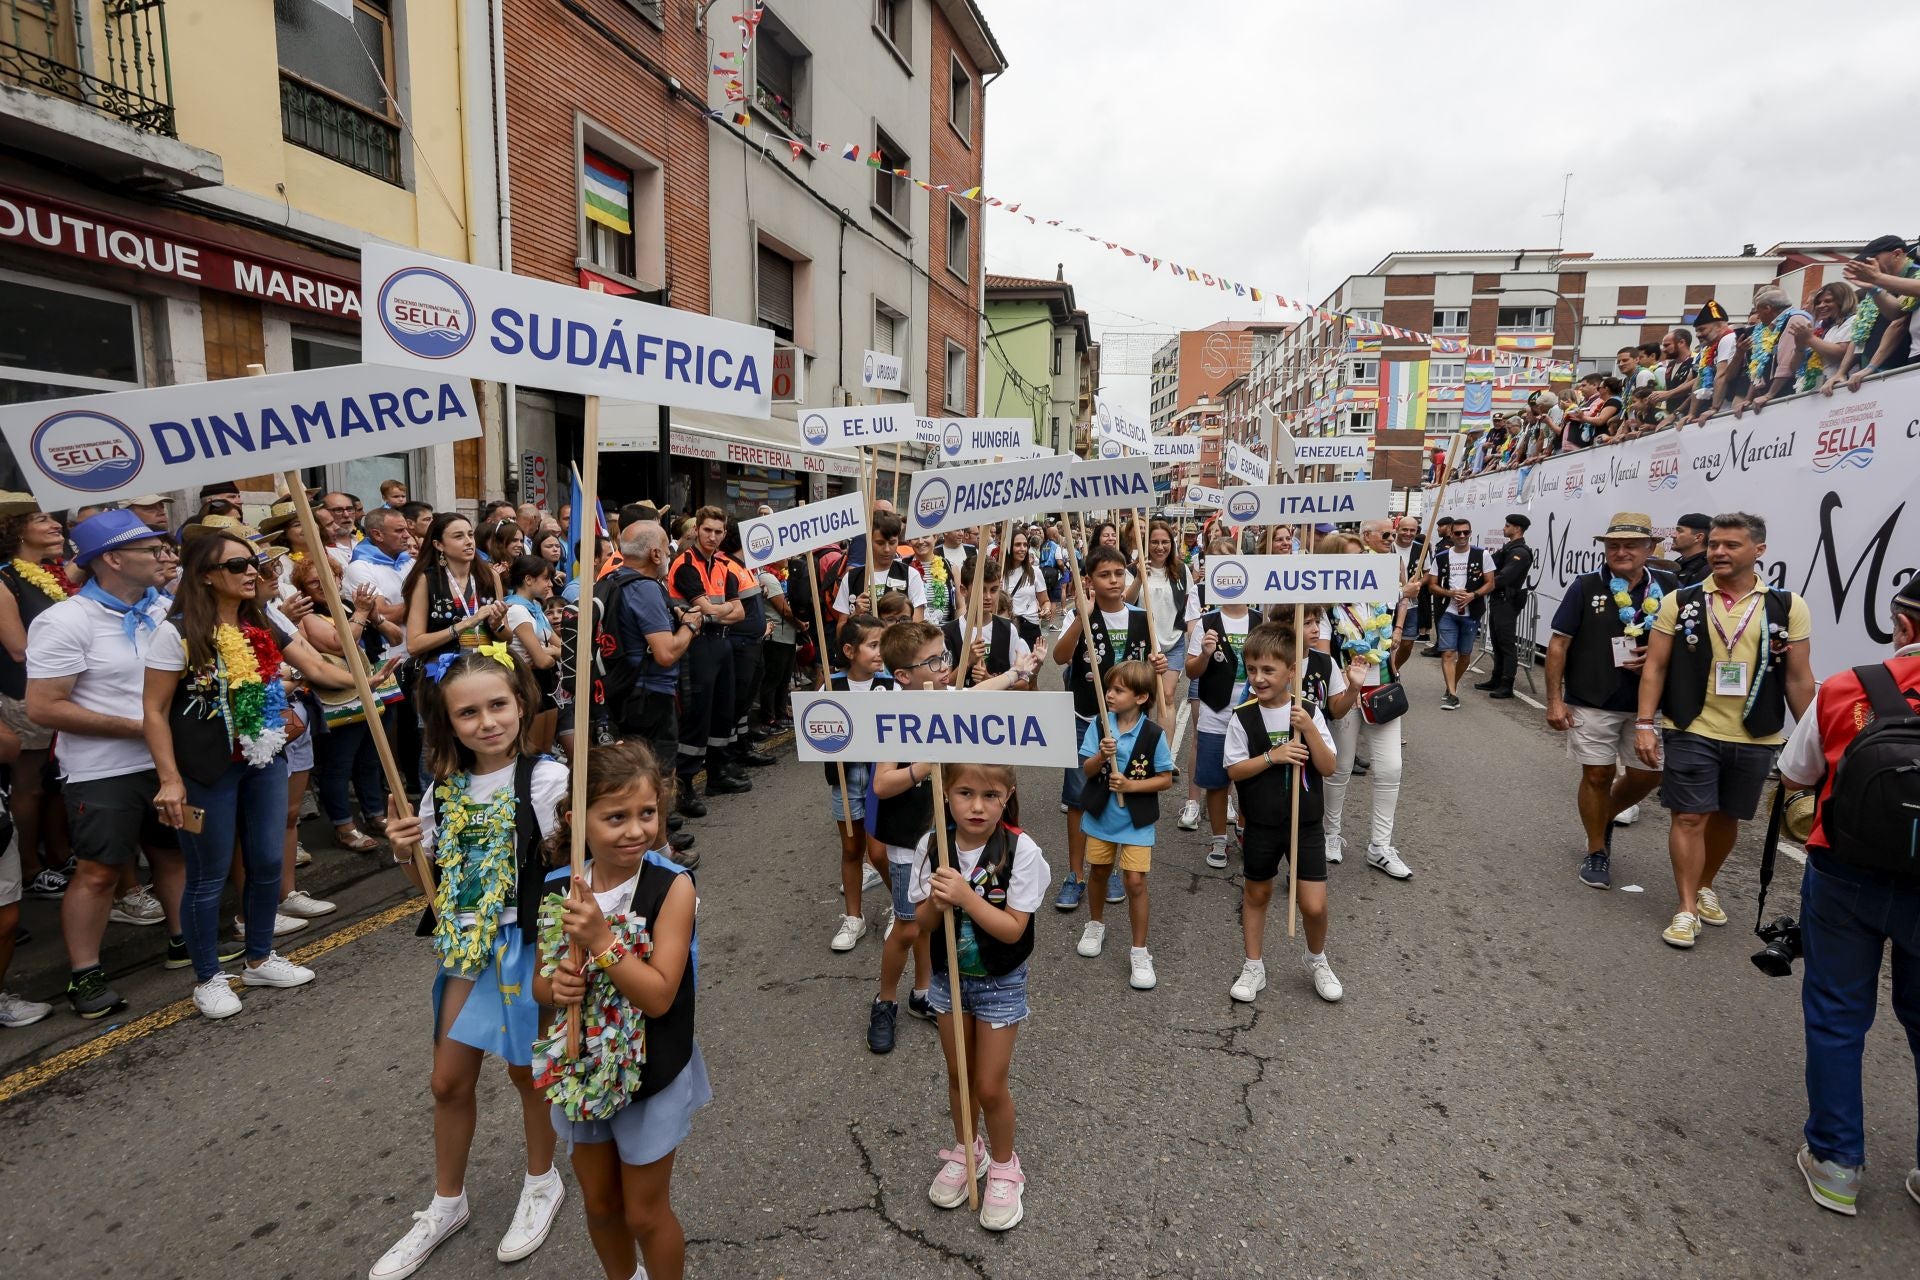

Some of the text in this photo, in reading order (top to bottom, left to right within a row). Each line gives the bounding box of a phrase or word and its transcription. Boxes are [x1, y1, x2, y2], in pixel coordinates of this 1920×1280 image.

[395, 305, 460, 330] SELLA
[490, 307, 762, 395] SUDÁFRICA
[876, 363, 898, 382] URUGUAY
[149, 383, 468, 465] DINAMARCA
[1114, 415, 1147, 444] BÉLGICA
[972, 426, 1021, 449] HUNGRÍA
[1815, 422, 1876, 455] SELLA
[53, 444, 128, 467] SELLA
[727, 444, 792, 468] FERRETERIA
[1154, 444, 1195, 455] ZELANDA
[1295, 445, 1364, 458] VENEZUELA
[1705, 429, 1796, 482] Marcial
[803, 456, 825, 472] FALO
[1240, 457, 1264, 483] ESPAÑA
[1648, 458, 1679, 479] SELLA
[1692, 452, 1721, 471] casa
[1565, 474, 1584, 490] SELLA
[1591, 472, 1606, 485] casa
[1596, 455, 1640, 494] Marcial
[953, 471, 1063, 514] PAISES BAJOS
[920, 499, 945, 512] SELLA
[1279, 494, 1355, 514] ITALIA
[778, 507, 859, 547] PORTUGAL
[751, 538, 771, 550] SELLA
[1216, 578, 1243, 586] SELLA
[1264, 569, 1379, 591] AUSTRIA
[810, 724, 845, 734] SELLA
[875, 714, 1047, 747] FRANCIA
